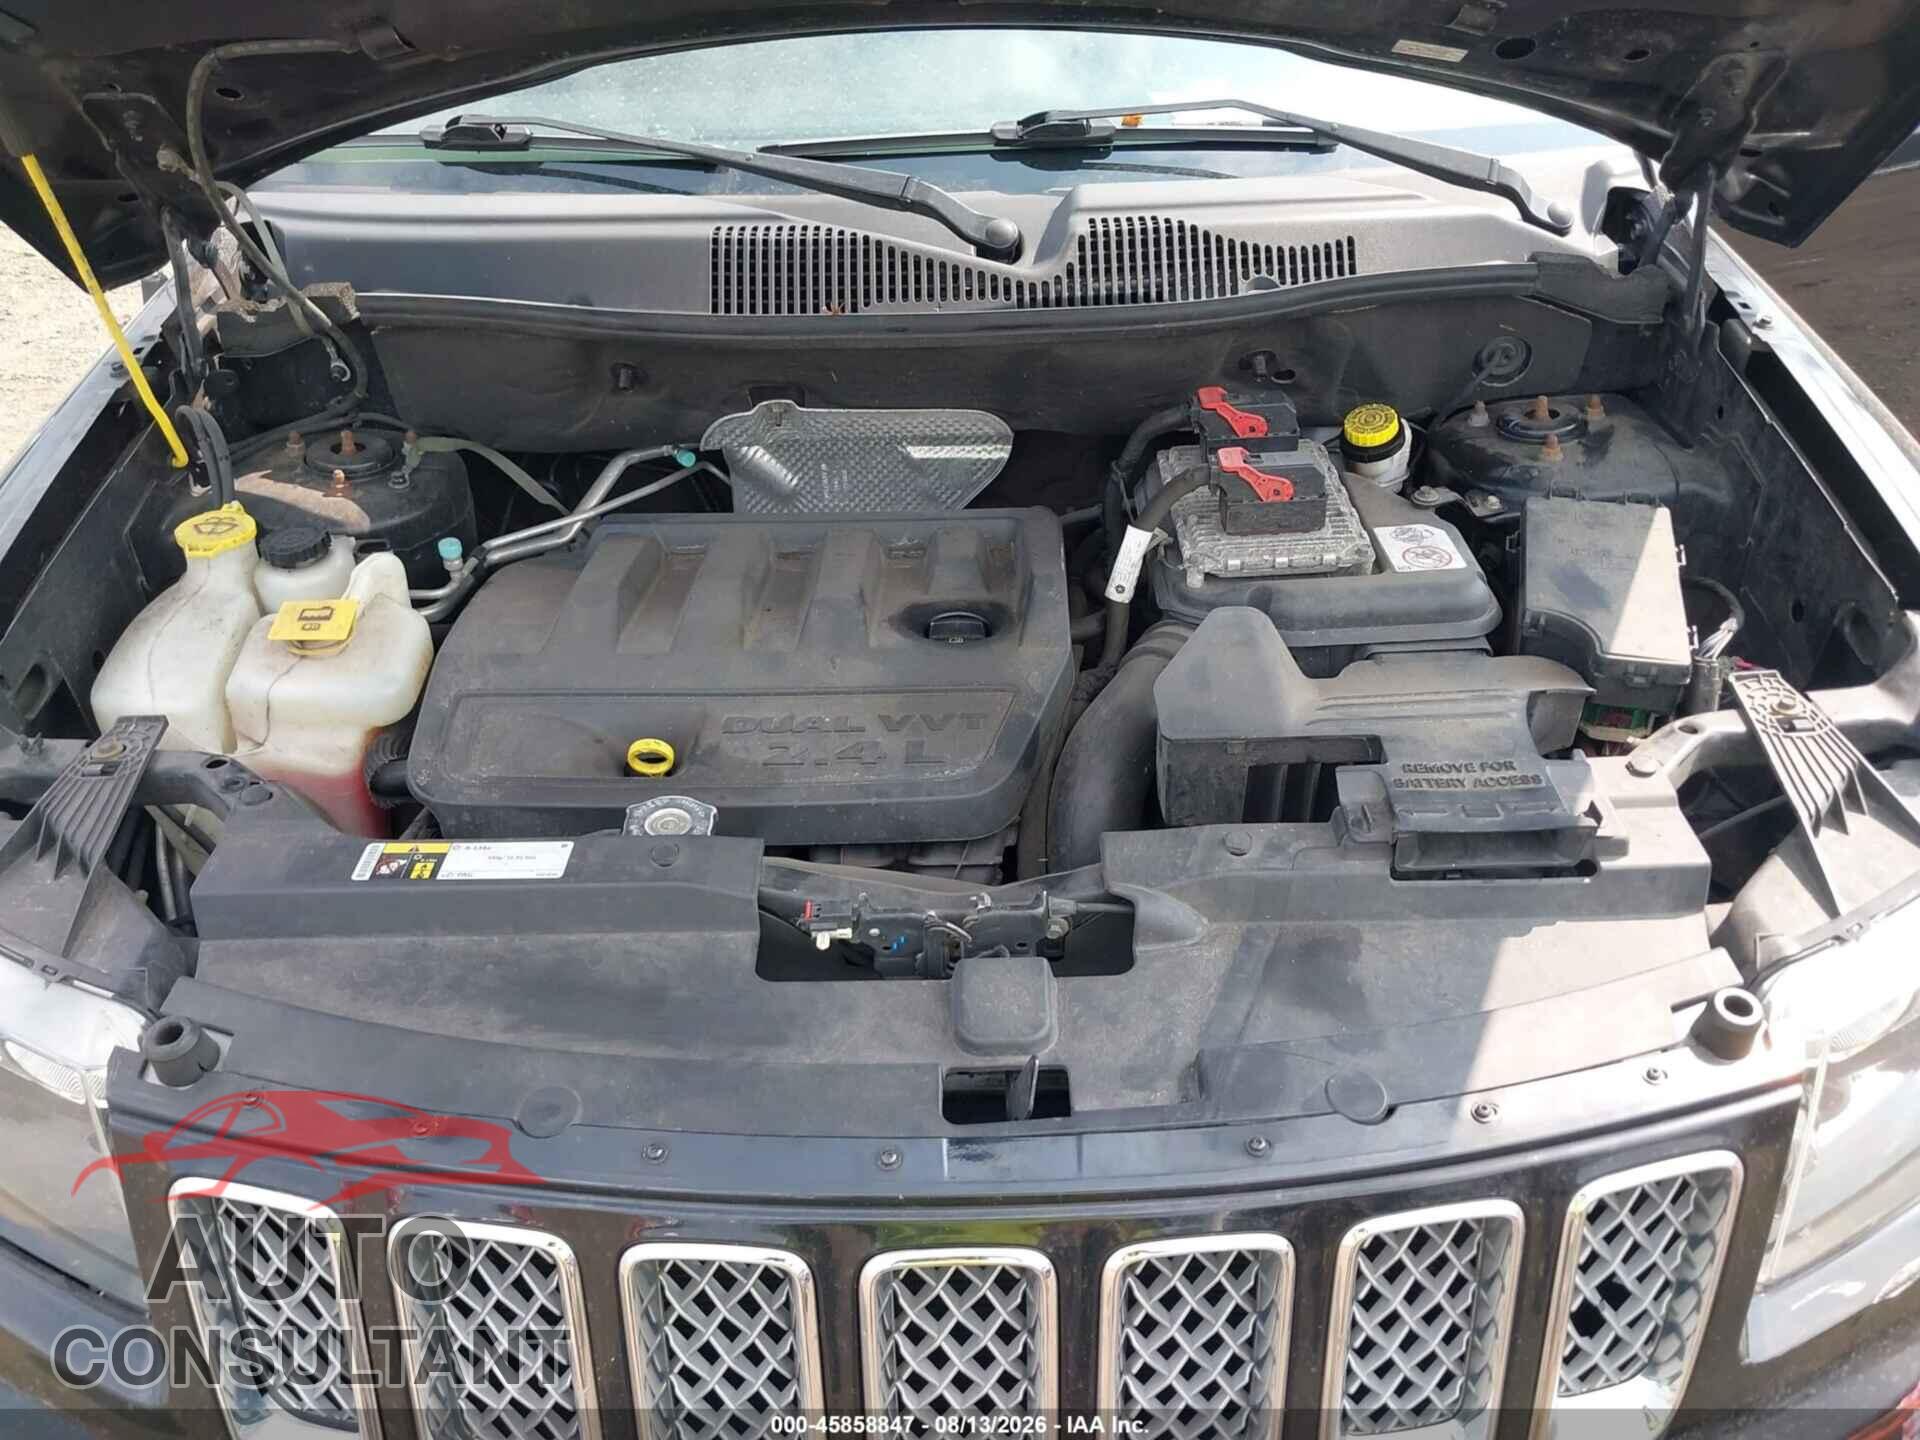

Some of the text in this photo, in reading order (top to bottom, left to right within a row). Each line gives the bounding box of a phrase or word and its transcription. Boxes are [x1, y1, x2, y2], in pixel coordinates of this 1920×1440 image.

[721, 712, 989, 734] DUAL VVT
[1401, 760, 1517, 775] REMOVE FOR
[1393, 774, 1543, 790] BATTERY ACCESS
